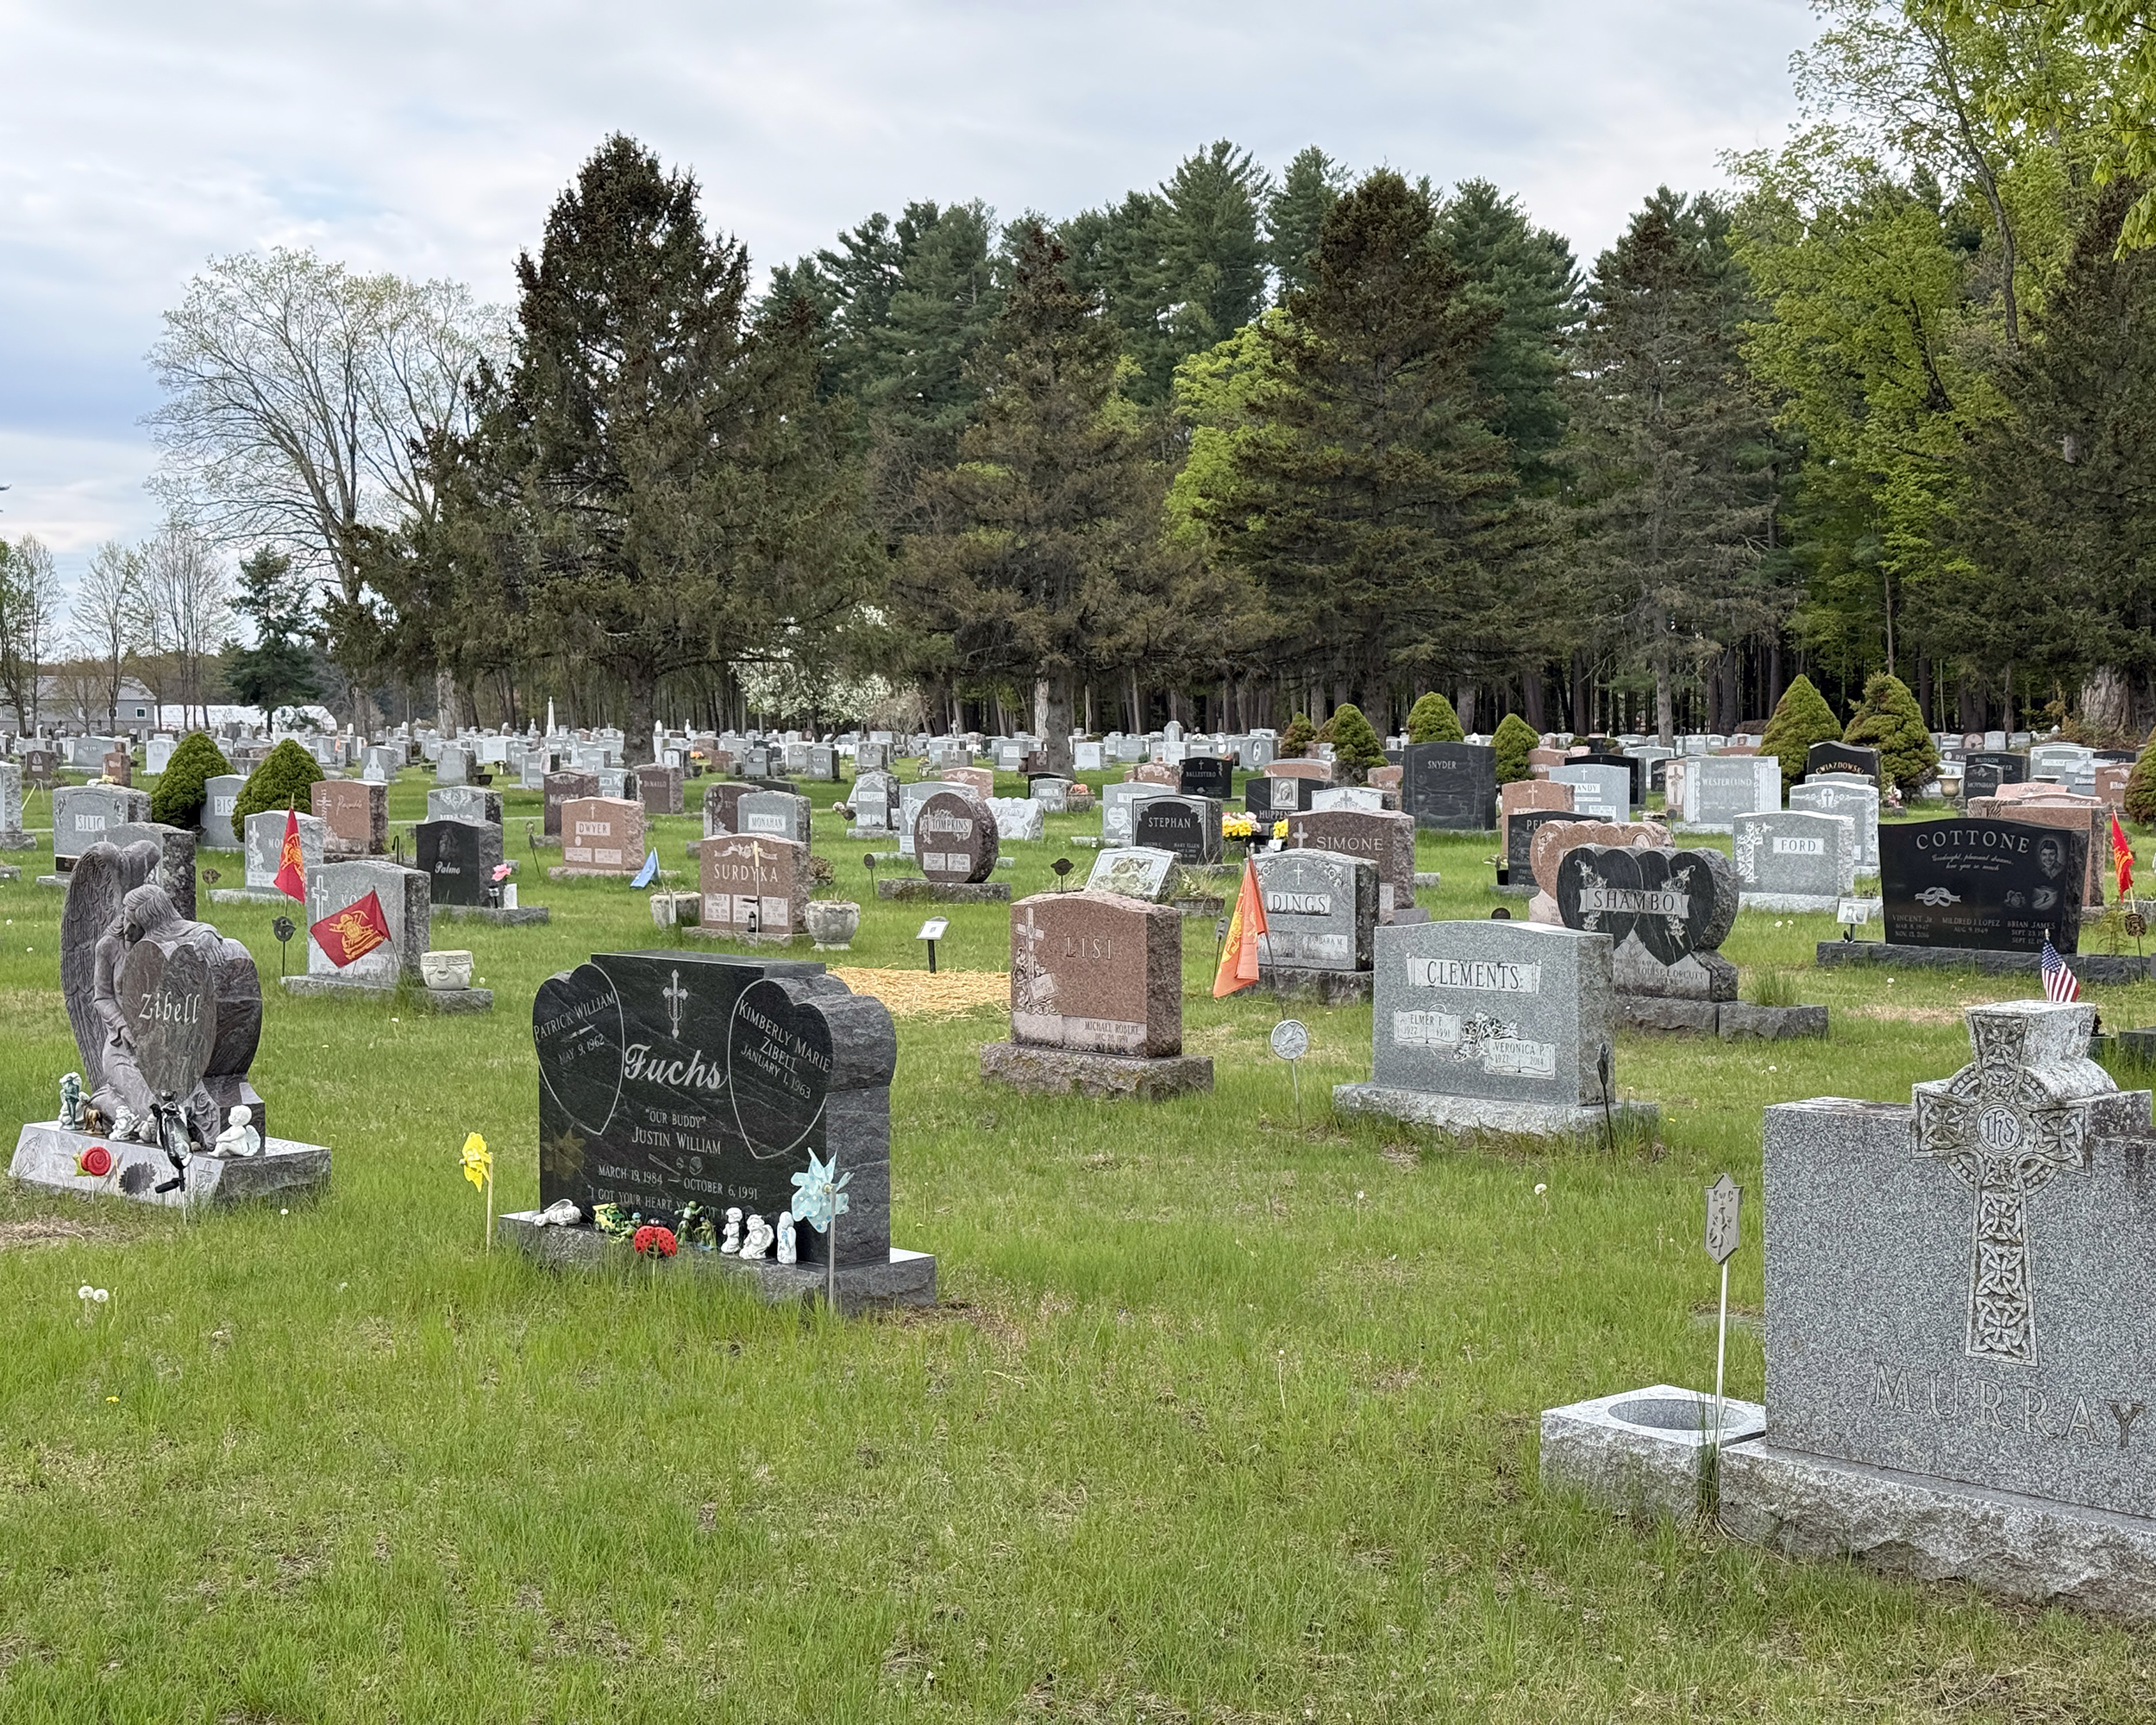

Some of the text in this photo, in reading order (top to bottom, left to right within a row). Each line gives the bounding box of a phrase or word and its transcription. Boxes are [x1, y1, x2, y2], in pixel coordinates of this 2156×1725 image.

[1427, 760, 1457, 769] SNYDER
[1814, 761, 1865, 775] GWIAZDOWSKI
[1702, 778, 1752, 787] WESTERLUND
[579, 823, 607, 834] DWYER
[751, 817, 783, 828] MONAHAN
[932, 819, 968, 831] TOMPKINS
[1148, 817, 1191, 828] STEPHAN
[1316, 836, 1384, 851] SIMONE
[1781, 839, 1816, 852] FORD
[1915, 830, 2030, 853] COTTONE
[714, 863, 779, 882] SURDYKA
[1272, 894, 1326, 913] DINGS
[1594, 890, 1676, 913] SHAMBO
[1892, 914, 1923, 923] VINCENT
[1066, 936, 1112, 961] LISI
[1427, 960, 1519, 989] CLEMENTS
[139, 992, 201, 1025] Zibell
[534, 990, 616, 1042] PATRICK WILLIAM
[1084, 1020, 1140, 1036] MICHAEL ROBERT
[1410, 1013, 1434, 1026] ELMER
[738, 999, 830, 1073] KIMBERLY MARIE
[558, 1047, 574, 1065] MAY
[586, 1032, 605, 1051] 1962
[760, 1036, 798, 1076] ZIBELL
[1495, 1041, 1535, 1056] VERONICA
[624, 1043, 730, 1089] Fuchs
[741, 1044, 780, 1077] JANUARY
[791, 1077, 812, 1099] 1963
[631, 1126, 721, 1155] JUSTIN WILLIAM
[599, 1164, 627, 1180] MARCH
[643, 1171, 663, 1185] 1984
[683, 1177, 724, 1195] OCTOBER
[738, 1186, 758, 1201] 1991
[598, 1189, 615, 1201] GOT
[618, 1191, 641, 1206] YOUR
[1871, 1360, 2147, 1450] MURRAY
